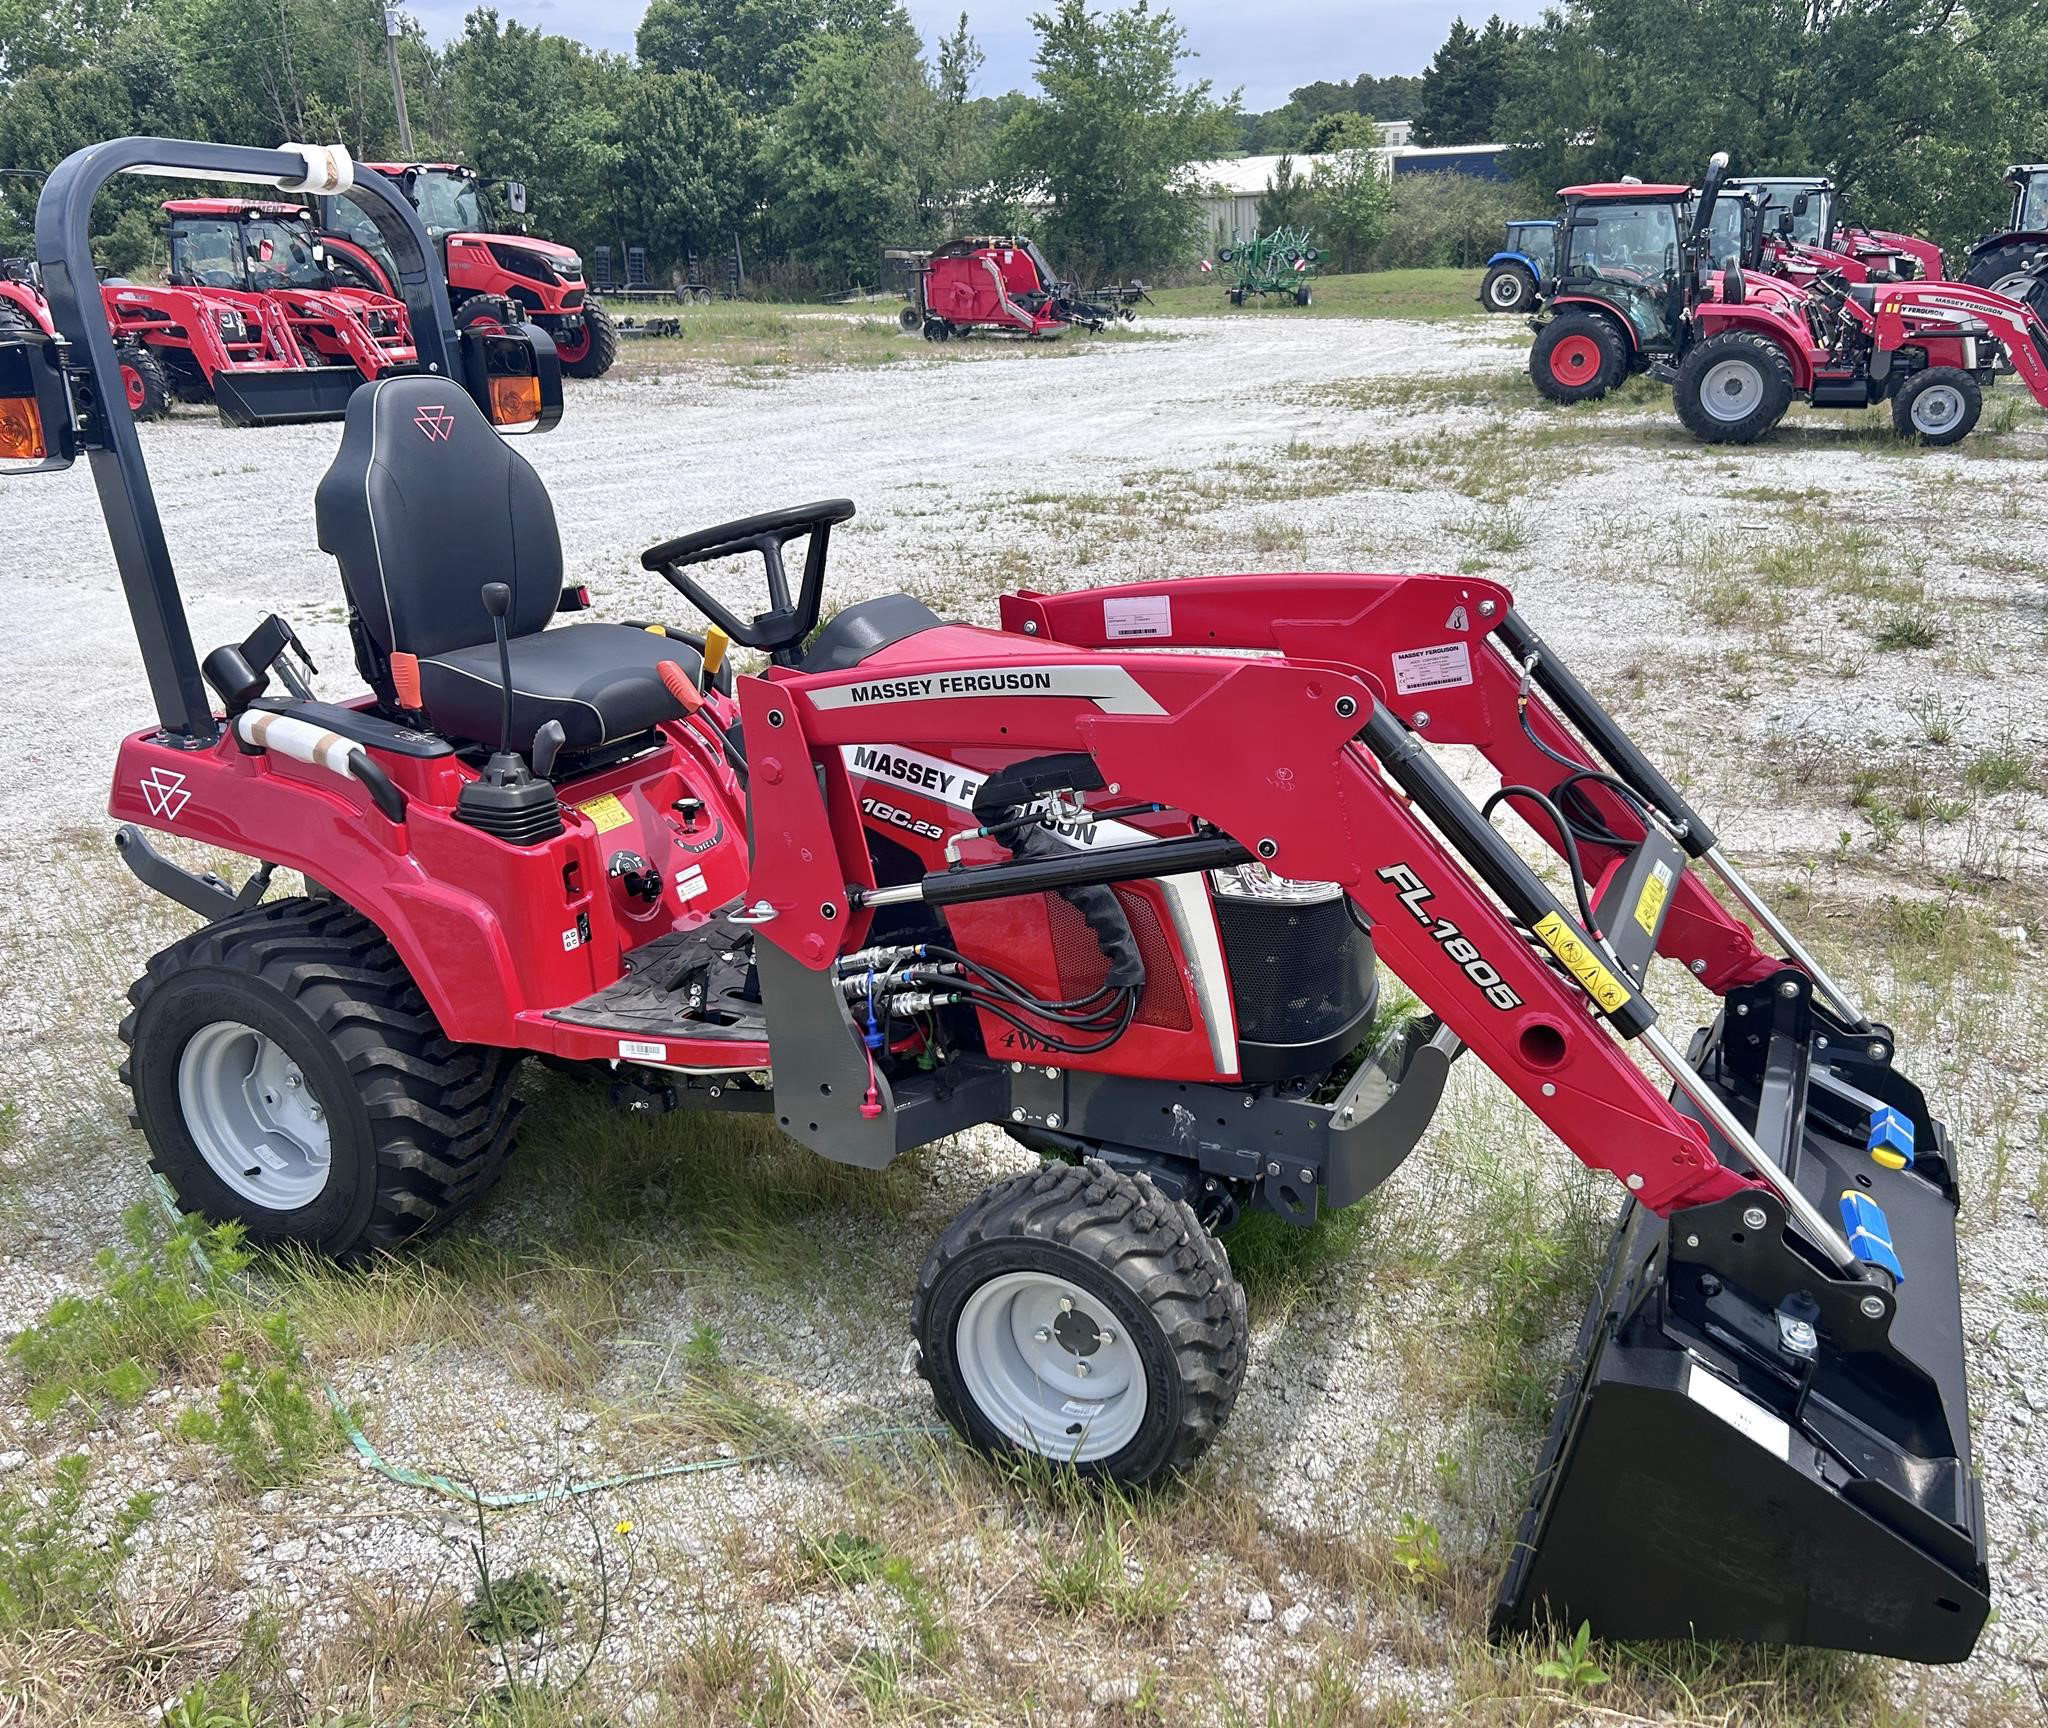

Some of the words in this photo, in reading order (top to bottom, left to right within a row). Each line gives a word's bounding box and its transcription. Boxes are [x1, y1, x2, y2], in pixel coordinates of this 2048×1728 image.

[1908, 306, 1945, 317] FERGUSON
[1935, 297, 1964, 306] MASSEY
[1966, 302, 2003, 315] FERGUSON
[1398, 650, 1424, 660] MASSEY
[1425, 645, 1459, 656] FERGUSON
[850, 679, 932, 702] MASSEY
[939, 673, 1051, 694] FERGUSON
[853, 746, 956, 794] MASSEY
[861, 797, 945, 841] 1GC.23
[1376, 862, 1526, 1011] FL.1805
